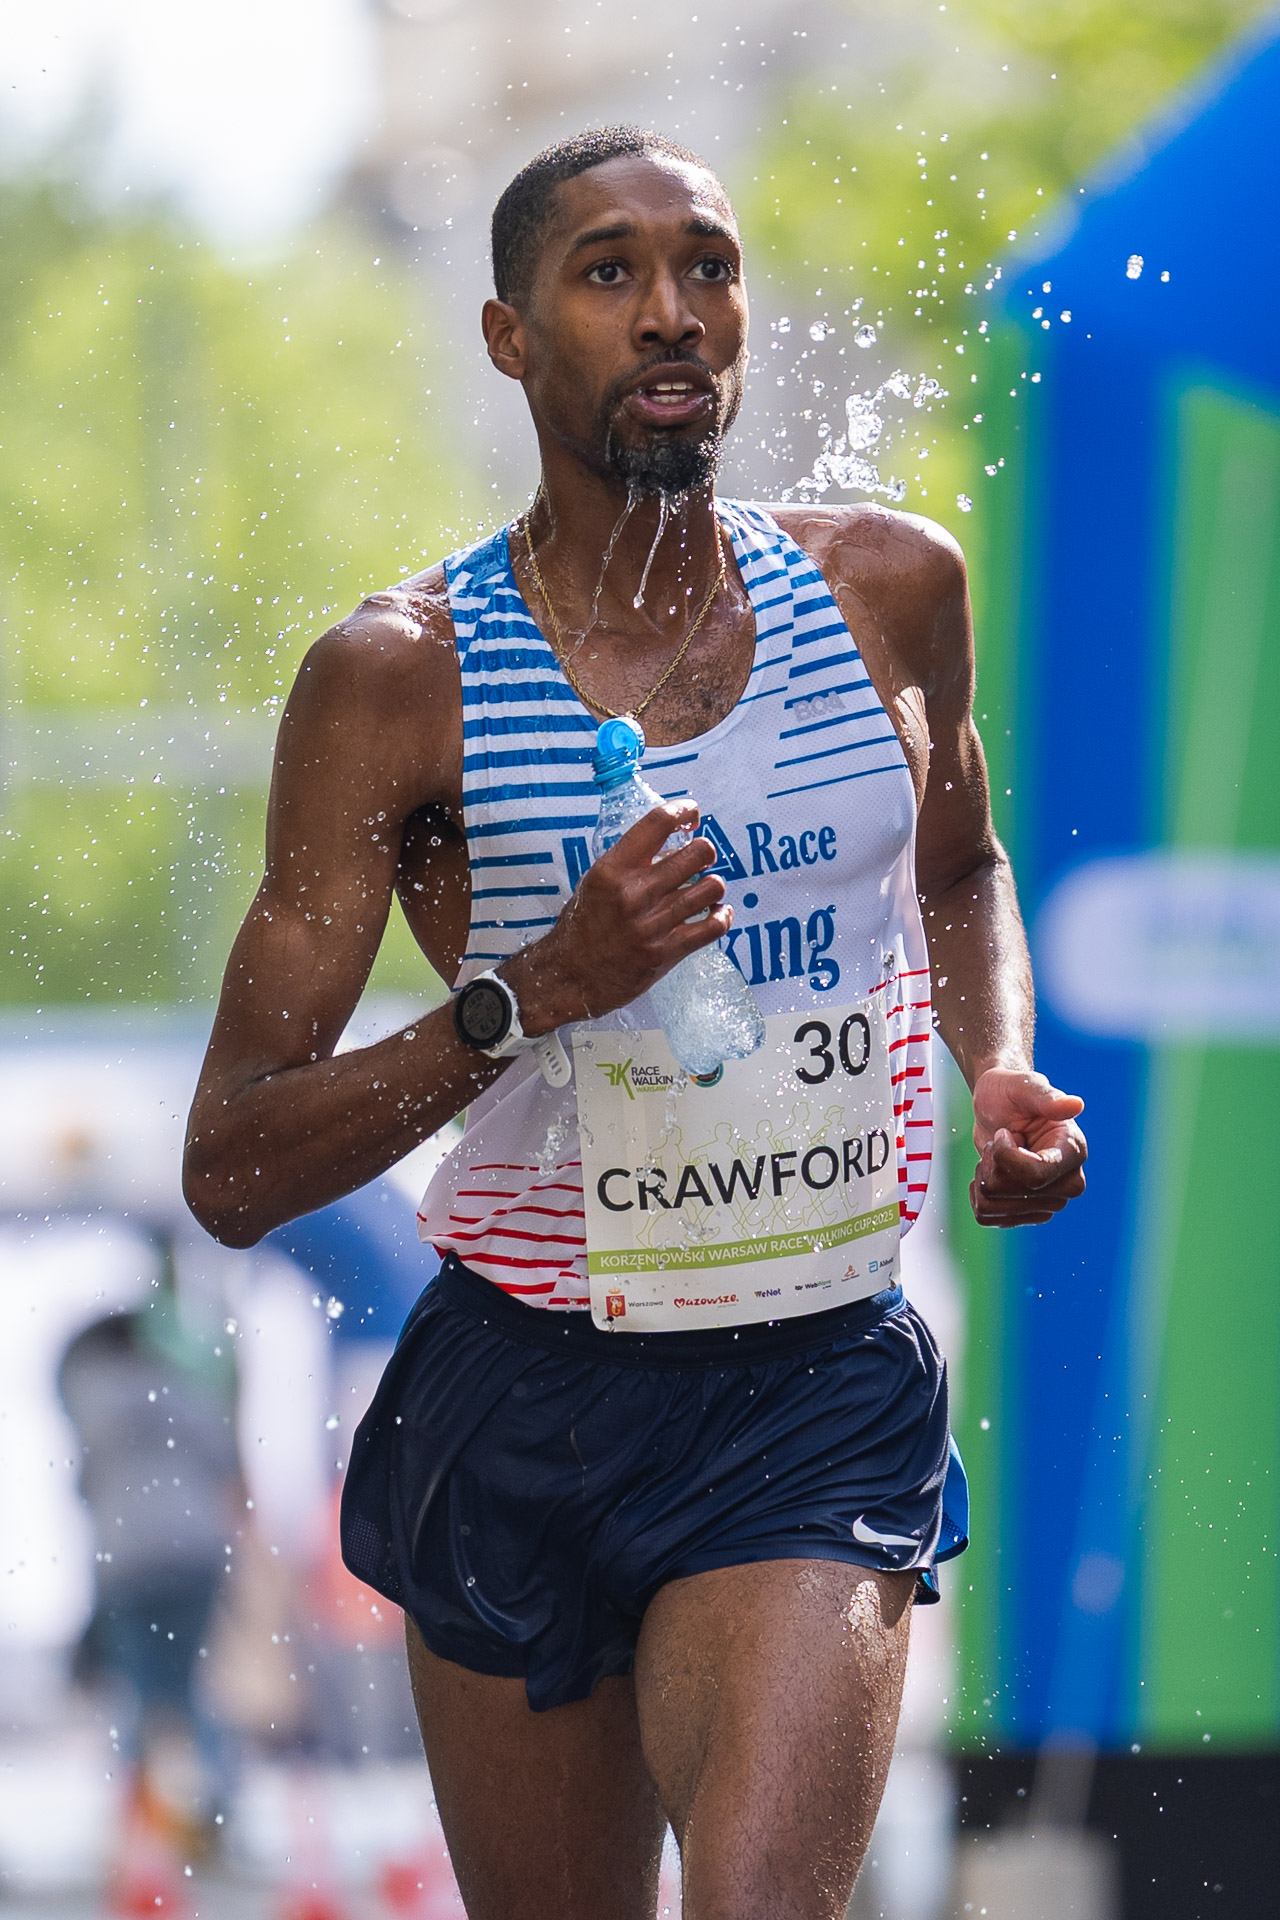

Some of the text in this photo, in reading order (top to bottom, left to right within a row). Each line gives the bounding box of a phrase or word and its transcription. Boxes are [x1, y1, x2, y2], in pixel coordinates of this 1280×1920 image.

[745, 821, 837, 877] Race
[631, 1066, 660, 1076] RACE
[793, 1012, 871, 1085] 30
[631, 1075, 676, 1087] WALKIN
[596, 1130, 890, 1212] CRAWFORD
[600, 1209, 894, 1268] KORZENIOWSKI WARSAW RACE WALKING CUP 2025
[628, 1300, 663, 1308] Warszawa
